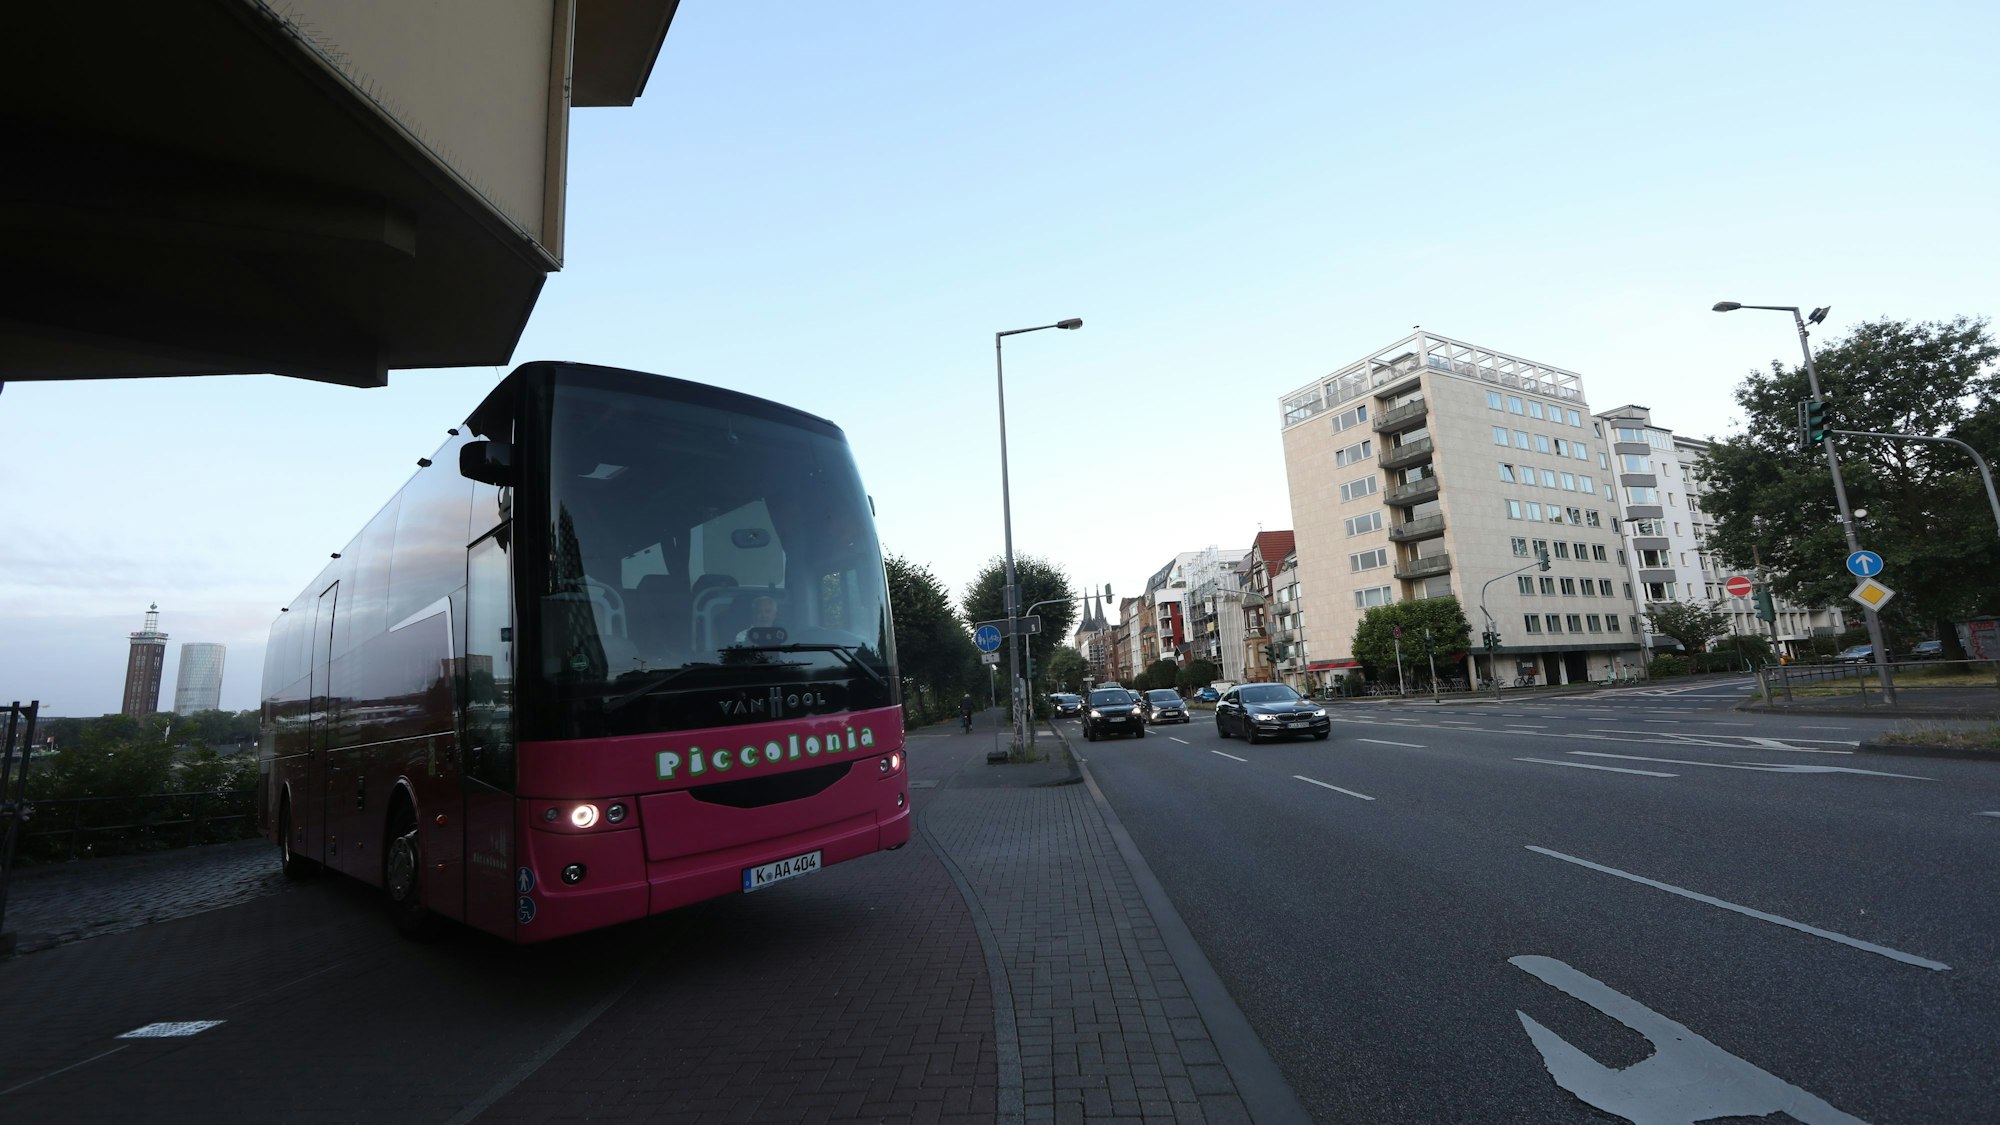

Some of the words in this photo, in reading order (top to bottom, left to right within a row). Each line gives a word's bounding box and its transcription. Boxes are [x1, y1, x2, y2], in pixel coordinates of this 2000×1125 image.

[656, 727, 875, 780] Piccolonia
[756, 868, 765, 884] K
[774, 861, 791, 878] AA
[793, 854, 816, 872] 404
